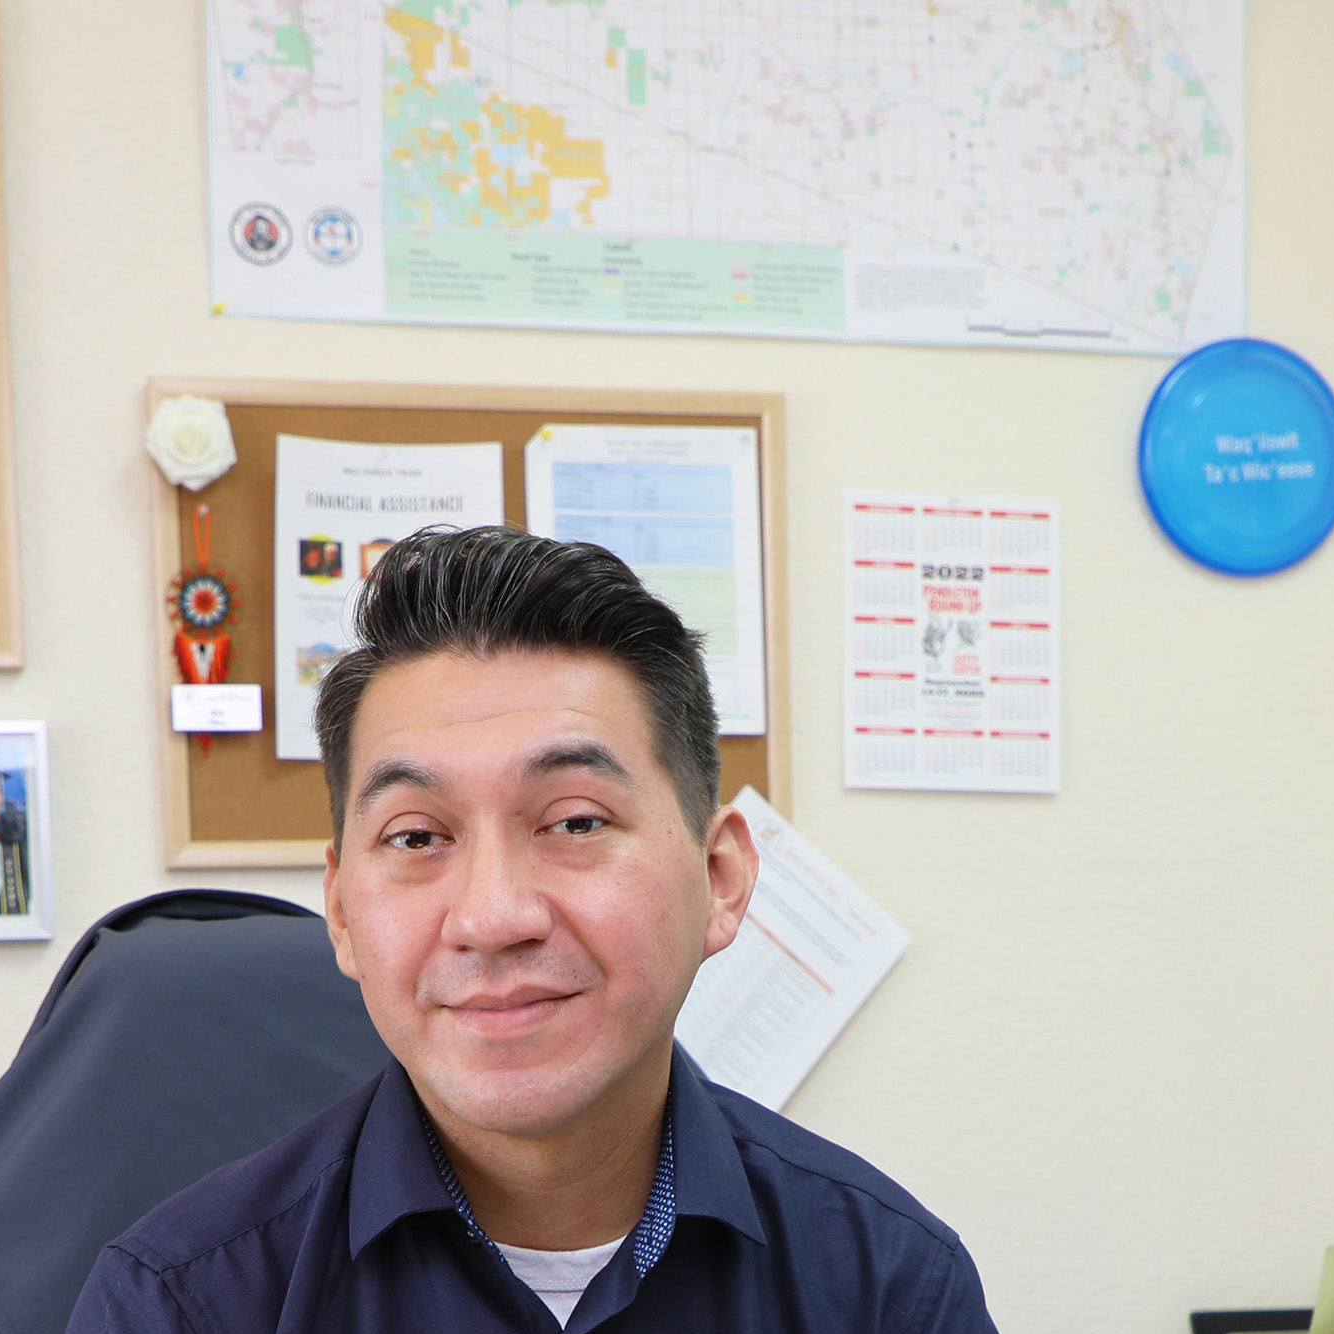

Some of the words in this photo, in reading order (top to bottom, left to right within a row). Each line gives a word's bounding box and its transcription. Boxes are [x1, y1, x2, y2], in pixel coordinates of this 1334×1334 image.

[306, 491, 373, 513] FINANCIAL
[379, 493, 465, 513] ASSISTANCE
[922, 565, 984, 580] 2022
